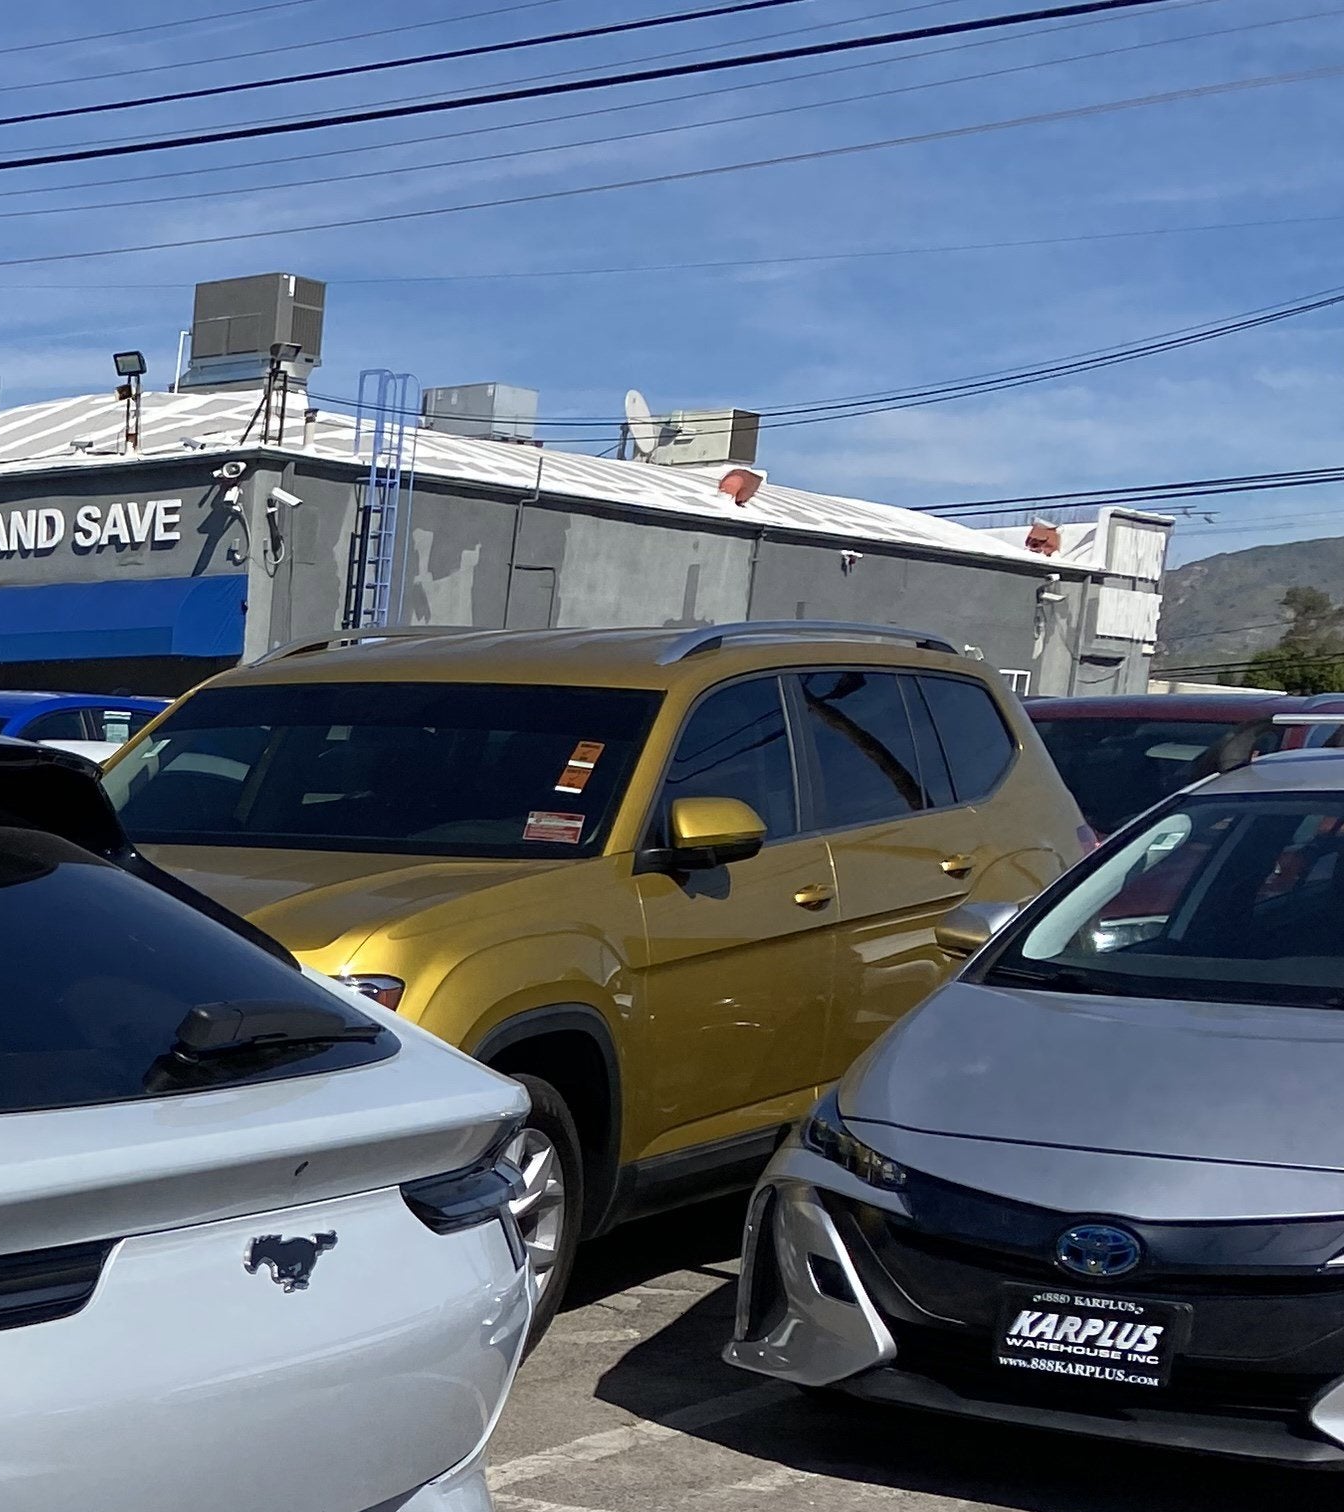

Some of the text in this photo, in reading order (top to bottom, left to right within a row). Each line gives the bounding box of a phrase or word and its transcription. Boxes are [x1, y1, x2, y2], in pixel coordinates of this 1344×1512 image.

[74, 498, 183, 548] SAVE
[1074, 1295, 1136, 1312] KARPLUS
[1007, 1309, 1165, 1353] KARPLUS
[1005, 1336, 1160, 1365] WAREHOUSE INC
